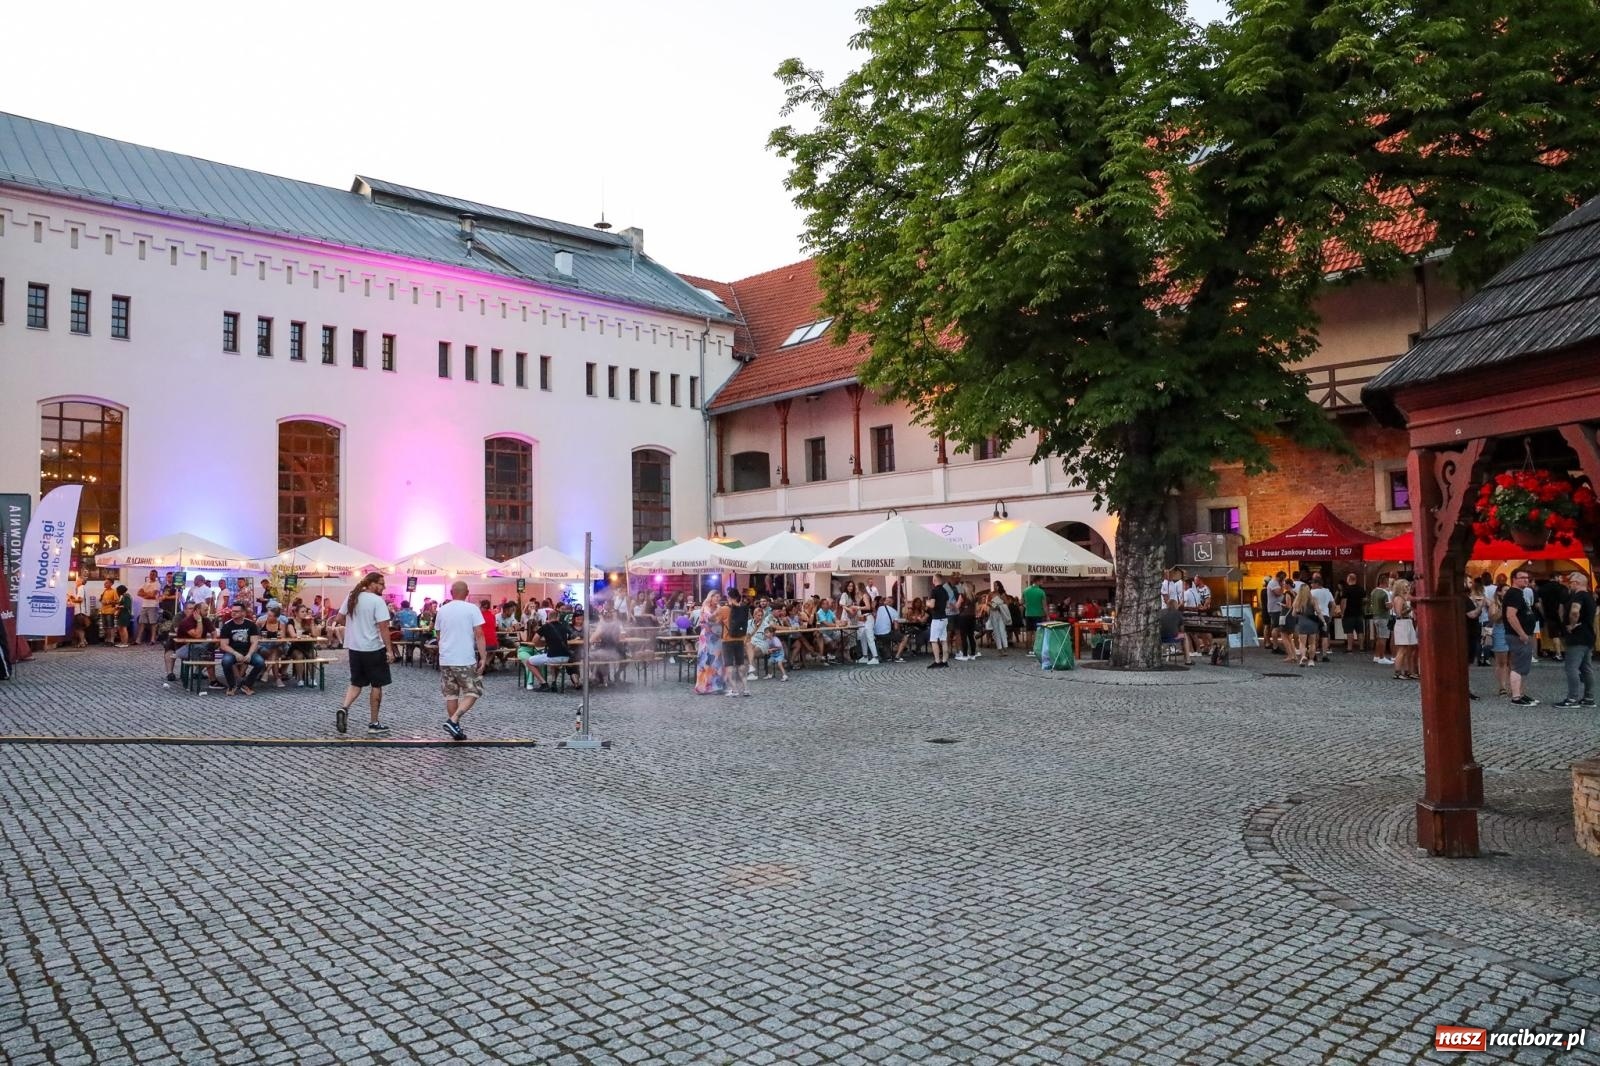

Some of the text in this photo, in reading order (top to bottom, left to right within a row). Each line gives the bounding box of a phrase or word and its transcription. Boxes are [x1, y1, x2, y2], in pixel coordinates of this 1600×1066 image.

[35, 520, 55, 589] Wodociągi
[1261, 549, 1280, 557] Browar
[770, 562, 809, 570] RACIBORSKIE
[851, 558, 895, 568] RACIBORSKIE
[922, 559, 962, 570] RACIBORSKIE
[1027, 564, 1068, 574] RACIBORSKIE
